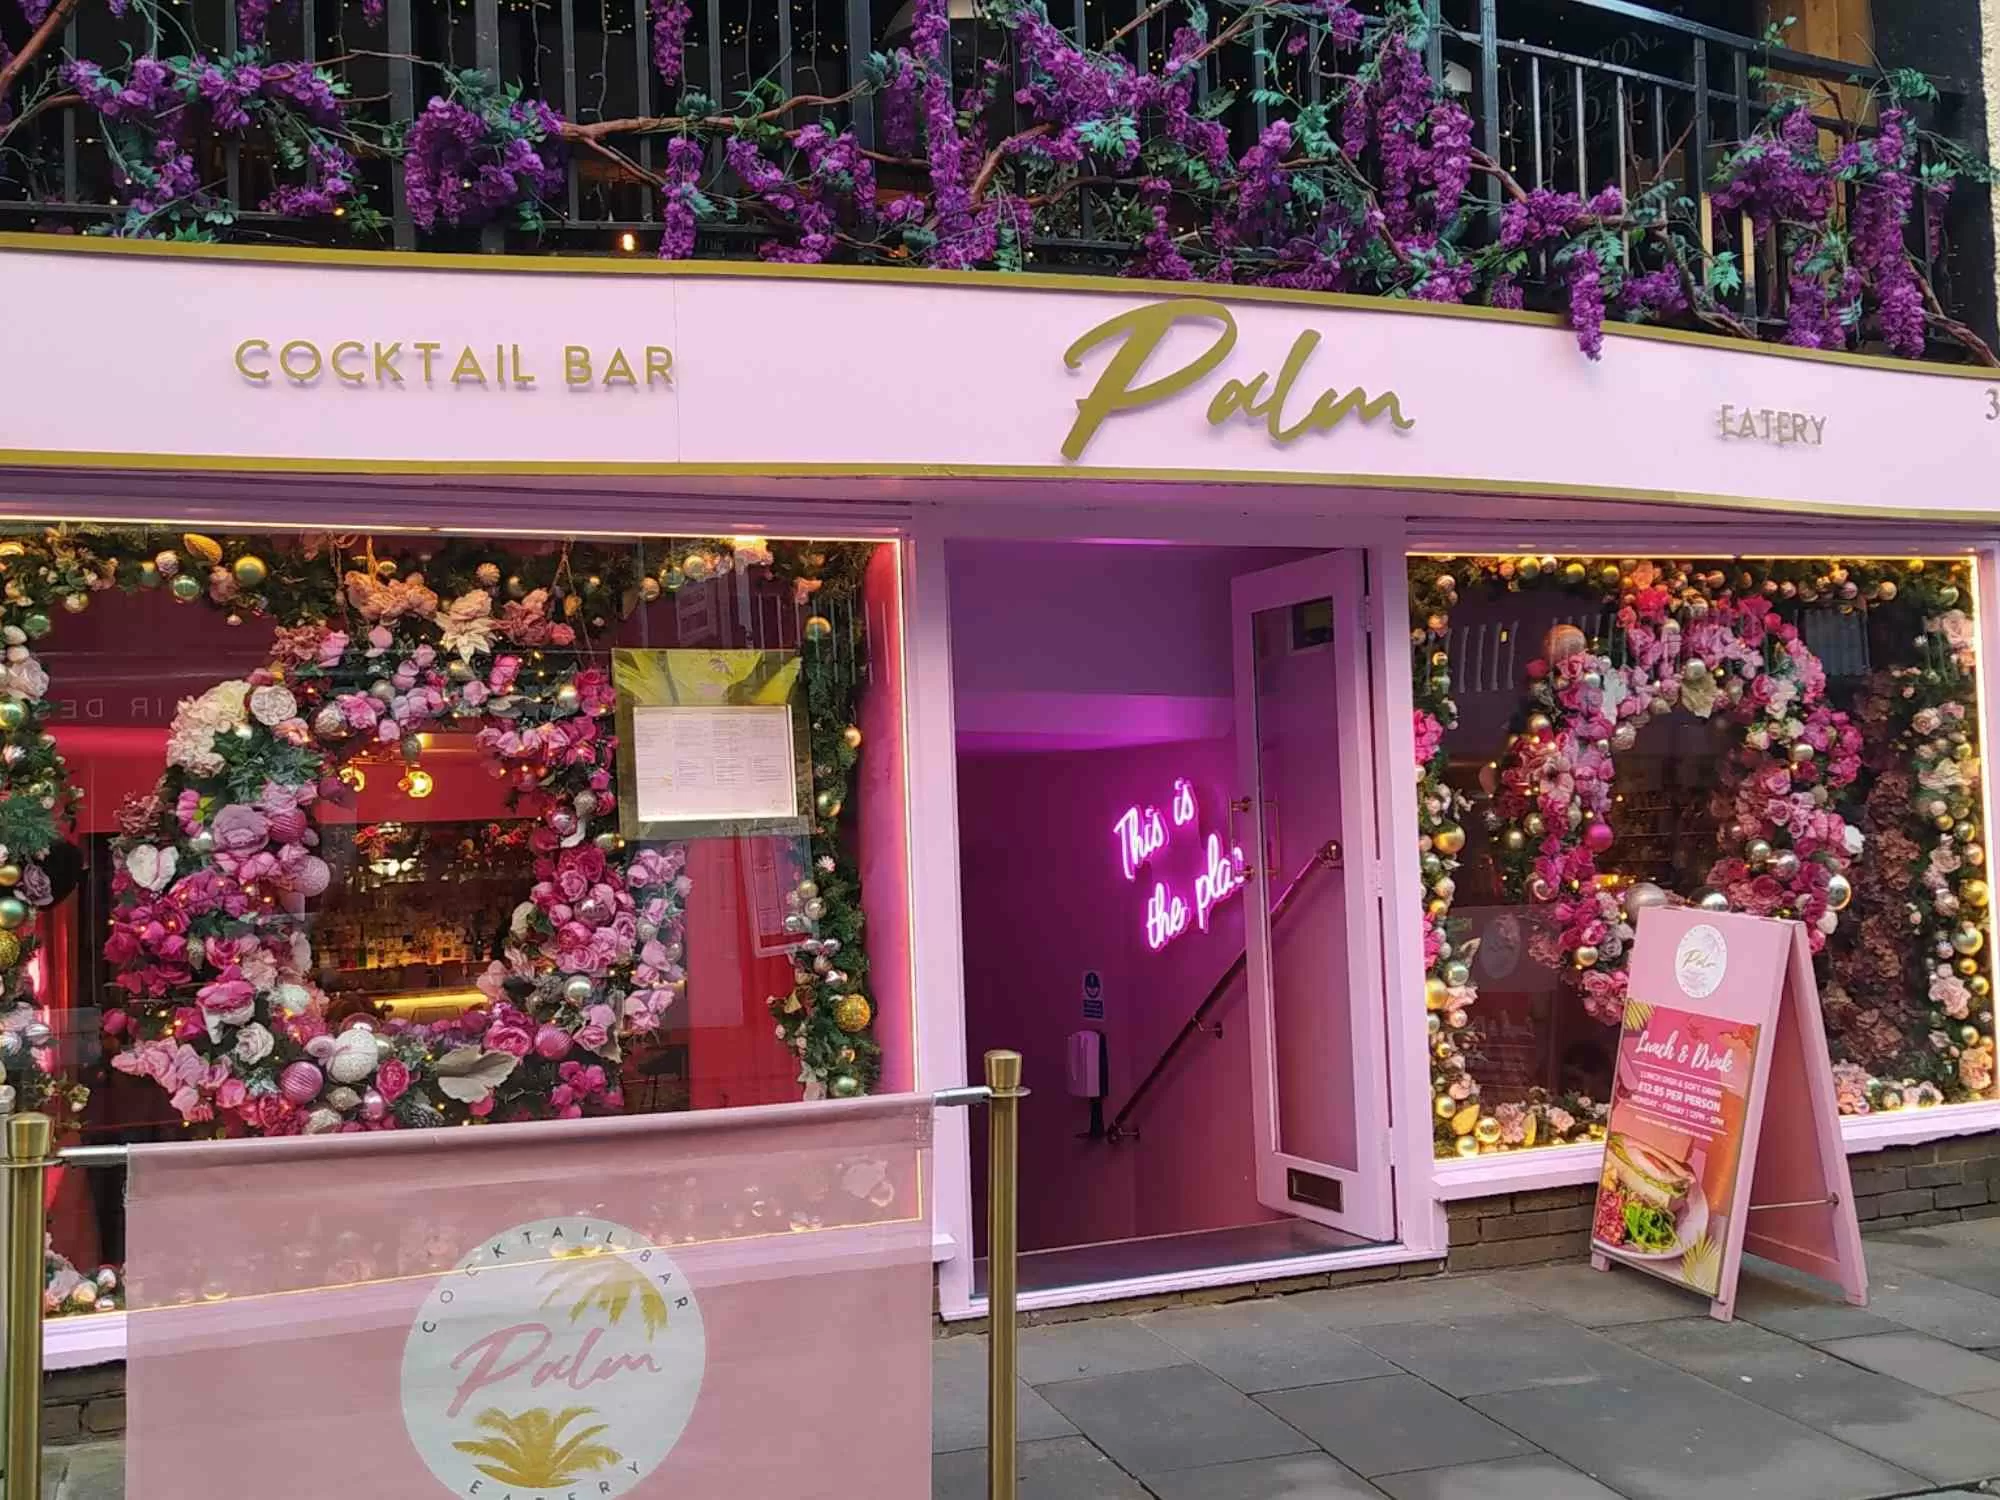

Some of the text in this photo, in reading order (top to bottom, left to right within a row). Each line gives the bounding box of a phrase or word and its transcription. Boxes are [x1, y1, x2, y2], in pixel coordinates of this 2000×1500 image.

[233, 338, 675, 388] COCKTAIL BAR
[1060, 298, 1416, 461] Palm
[1717, 403, 1827, 446] EATERY
[1113, 778, 1195, 880] This is
[1147, 882, 1187, 949] the
[1635, 1030, 1679, 1060] Lunch
[1690, 1042, 1733, 1072] Drink
[1665, 1088, 1683, 1102] PER
[1684, 1093, 1721, 1113] PERSON
[422, 1225, 689, 1334] COCKTAIL BAR
[447, 1322, 662, 1418] Palm
